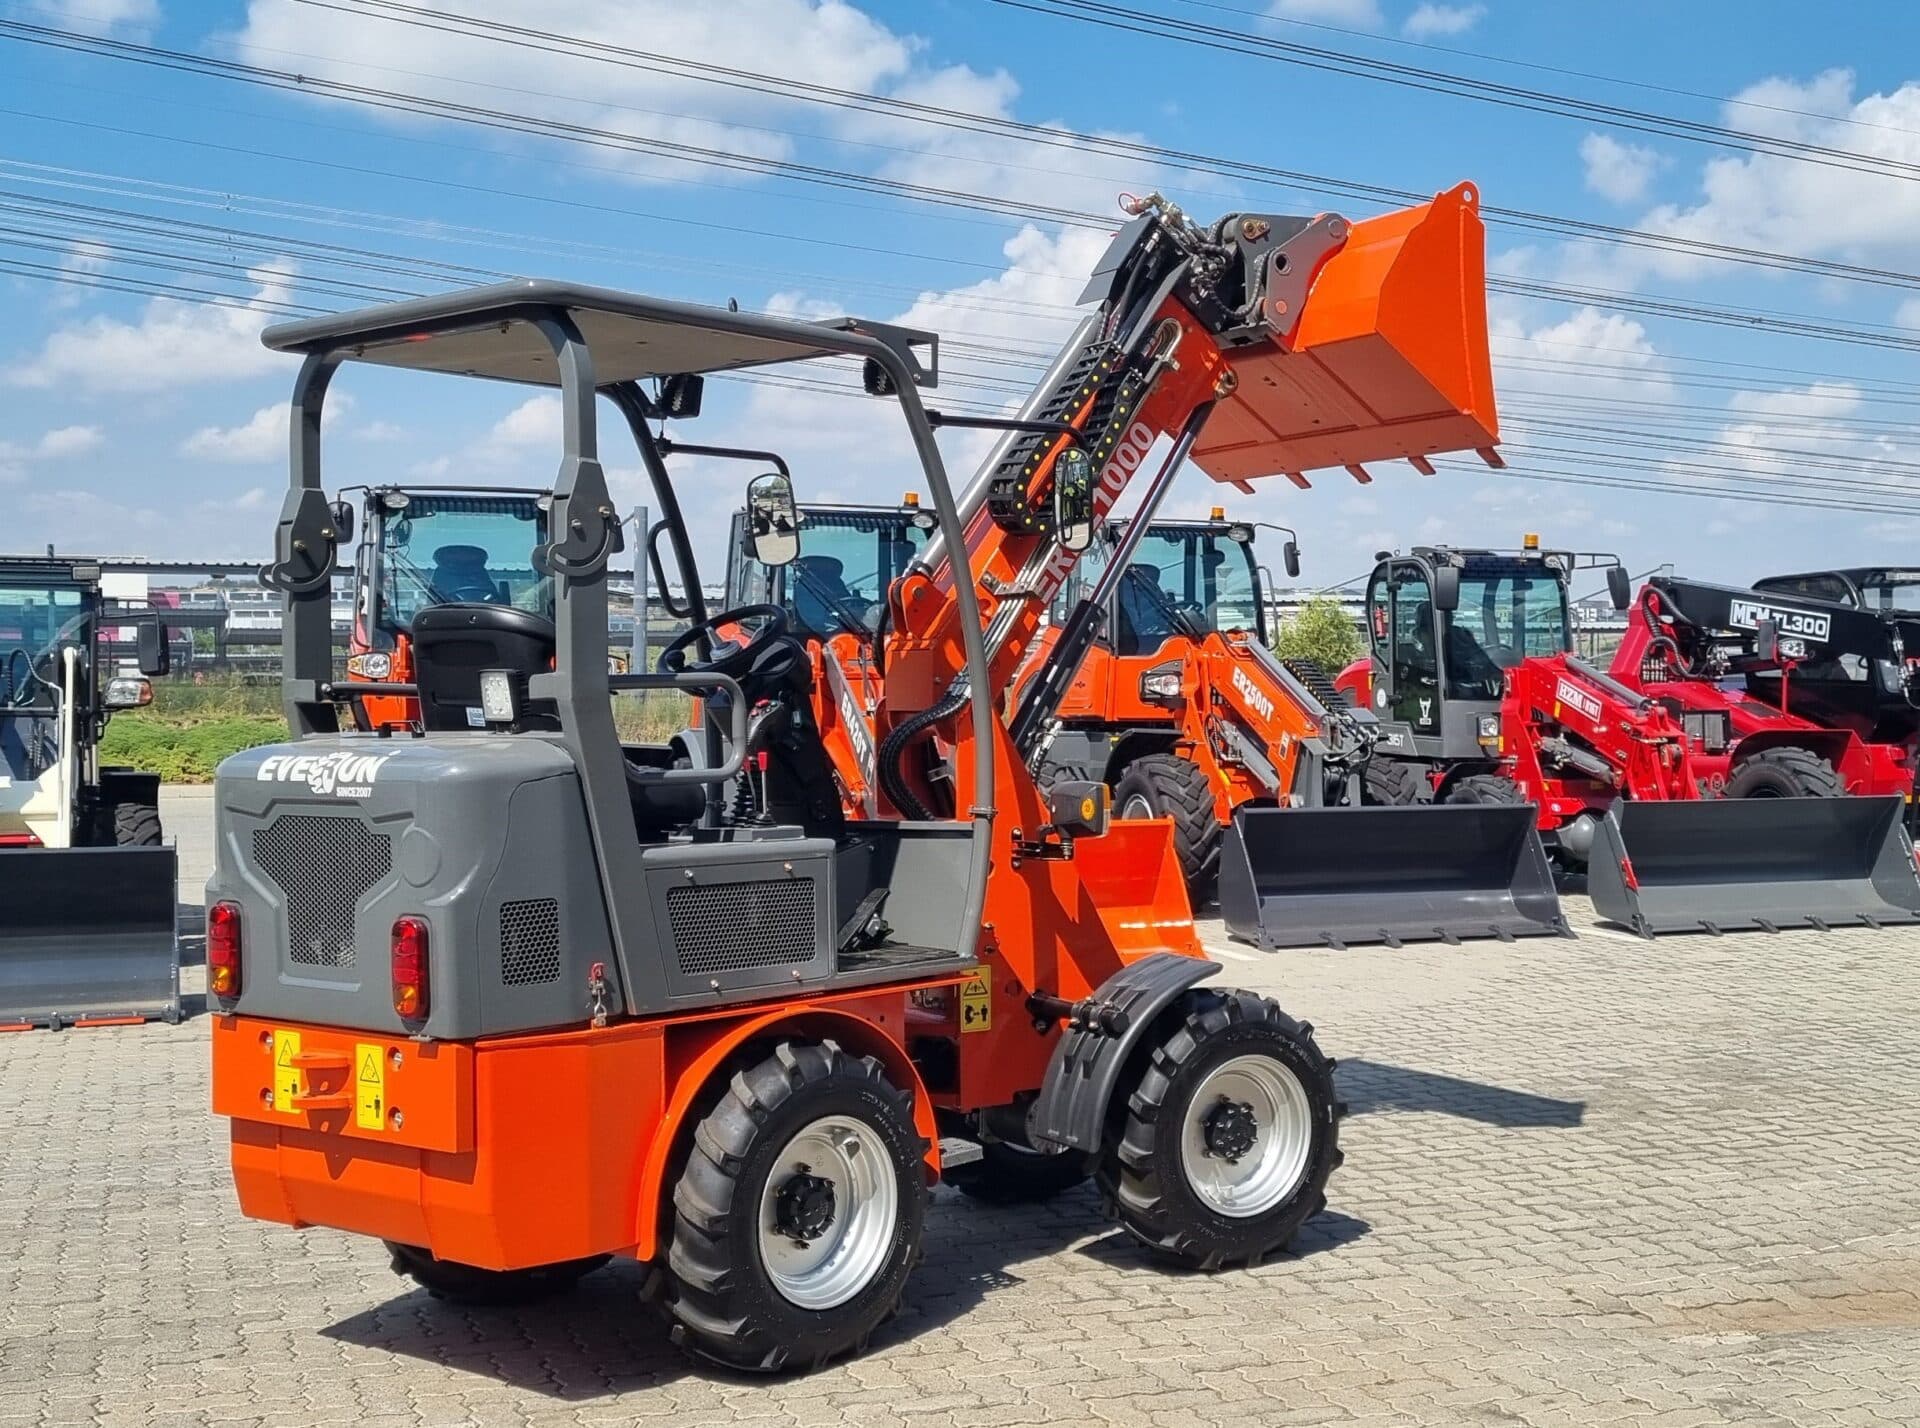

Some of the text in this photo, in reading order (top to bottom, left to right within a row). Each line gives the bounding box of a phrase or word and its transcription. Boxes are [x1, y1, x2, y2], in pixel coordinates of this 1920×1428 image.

[1036, 422, 1155, 604] ER1000
[1733, 603, 1770, 626] MCM
[1232, 665, 1275, 723] ER2500T
